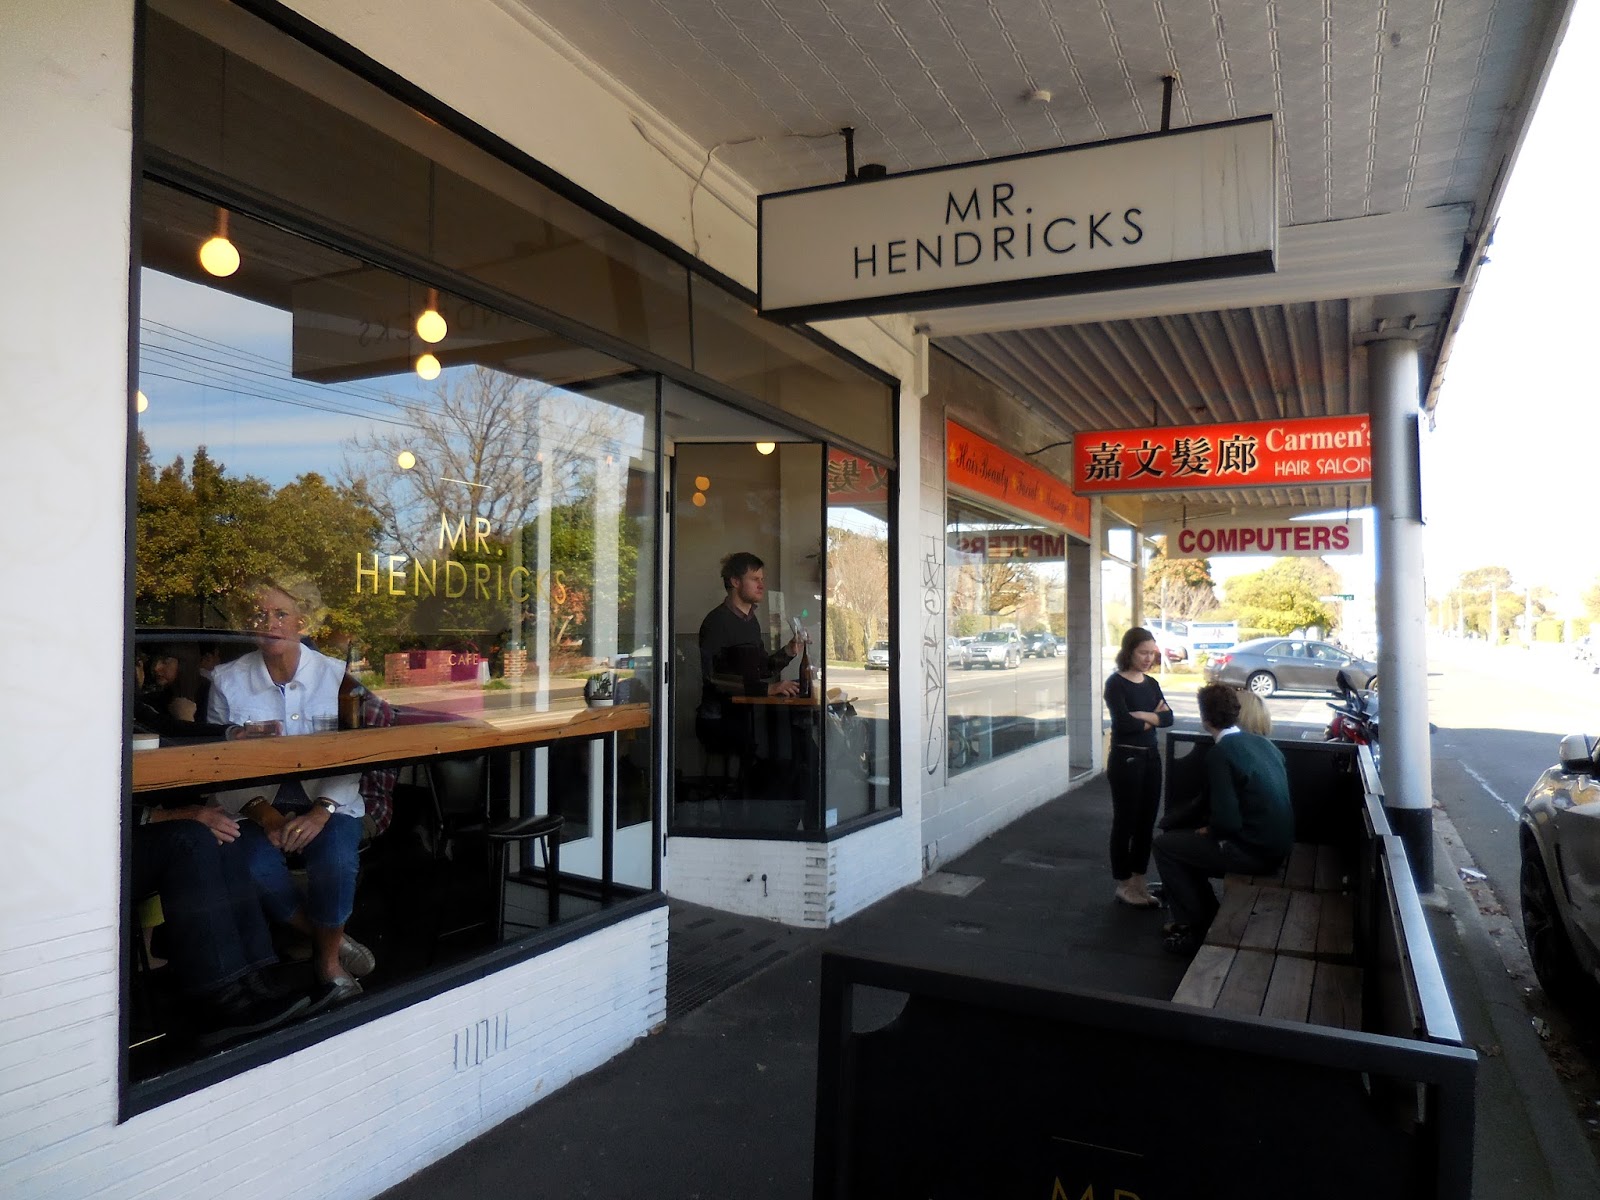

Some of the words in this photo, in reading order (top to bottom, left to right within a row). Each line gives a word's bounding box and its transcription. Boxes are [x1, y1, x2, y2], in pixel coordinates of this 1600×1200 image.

[945, 182, 1032, 225] MR.
[853, 207, 1144, 279] HENDRICKS
[1083, 434, 1260, 481] 嘉文髮廊
[1274, 458, 1310, 477] HAIR
[438, 512, 503, 556] MR.
[1177, 524, 1351, 554] COMPUTERS
[356, 552, 567, 605] HENDRICKS
[448, 653, 479, 666] CAFE
